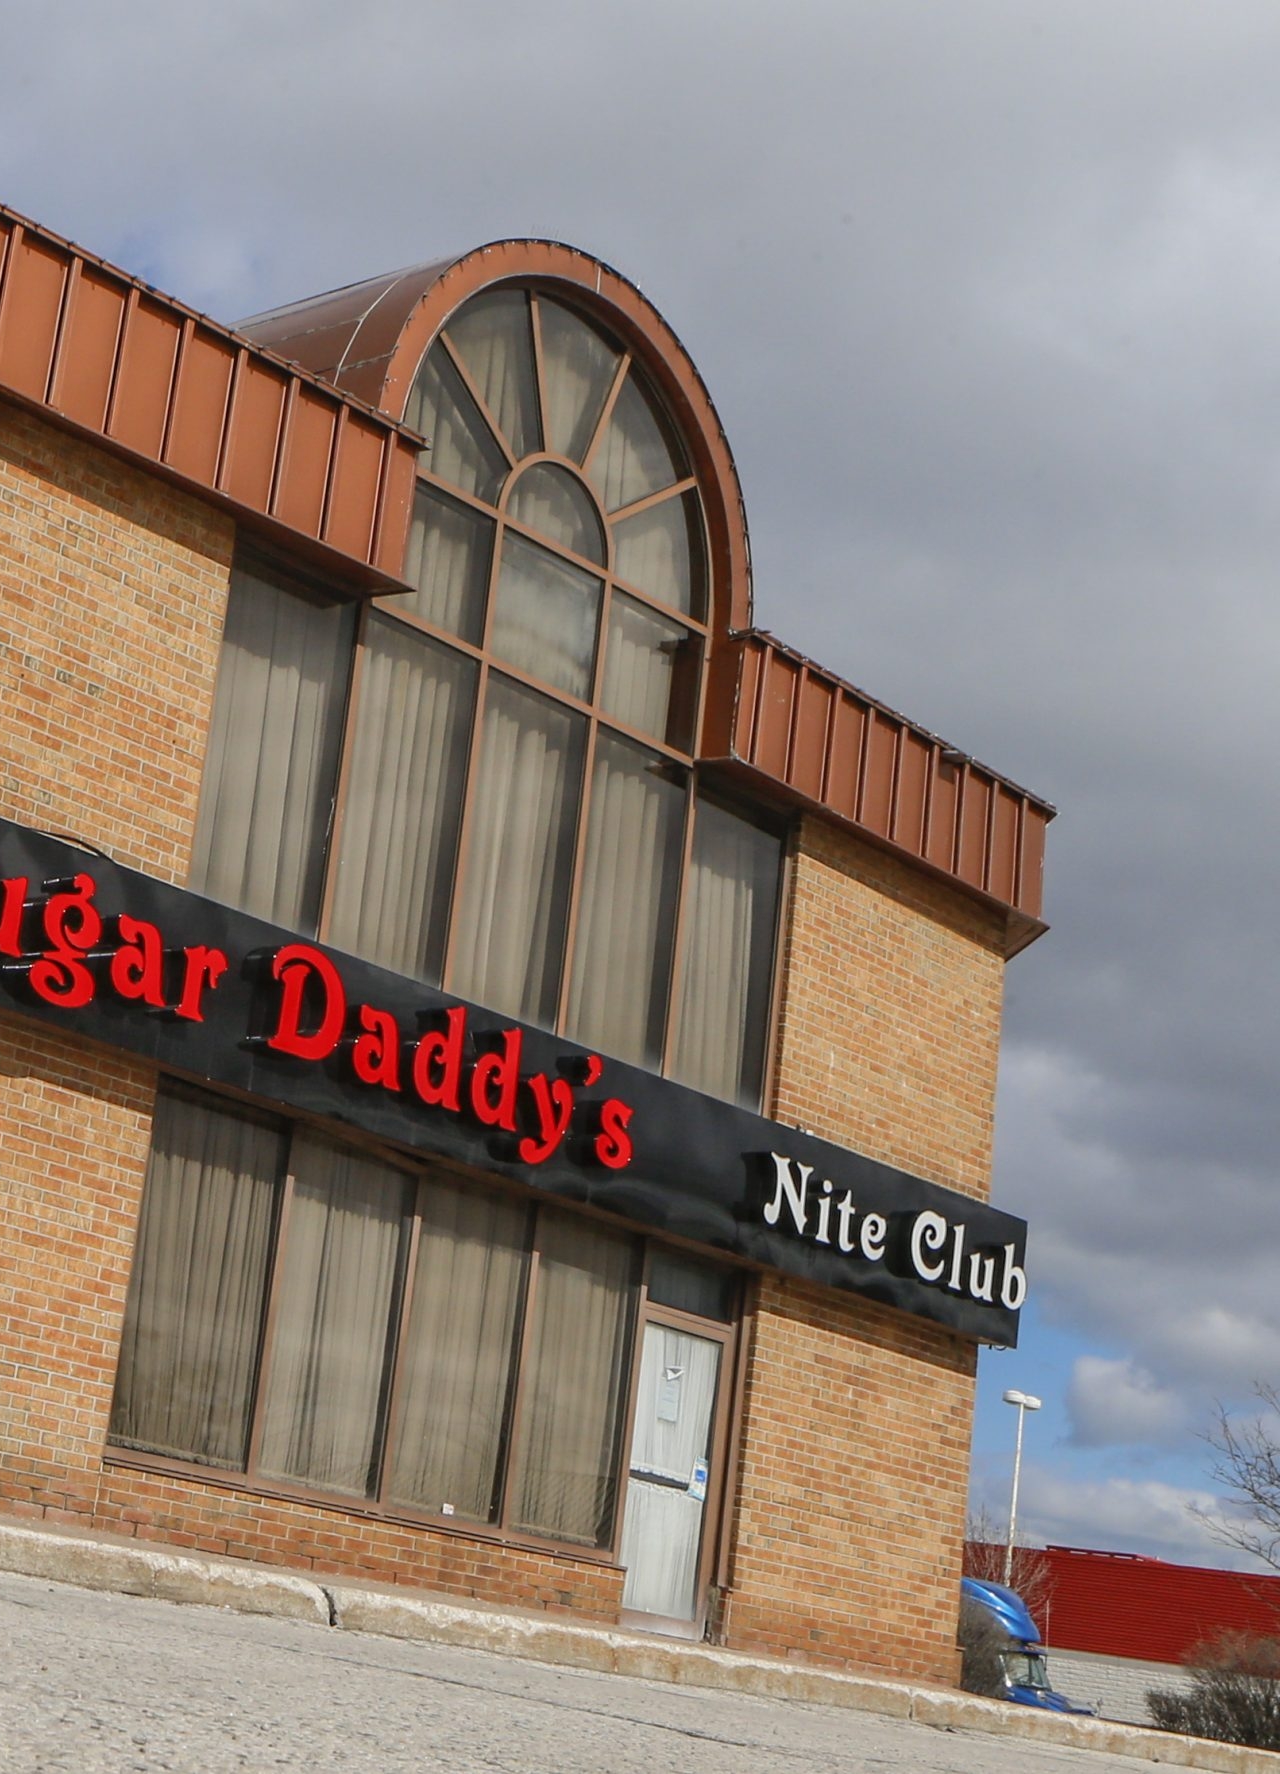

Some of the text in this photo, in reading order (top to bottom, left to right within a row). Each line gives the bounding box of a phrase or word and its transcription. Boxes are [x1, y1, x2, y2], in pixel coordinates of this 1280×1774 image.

[267, 943, 634, 1169] Daddy's
[763, 1150, 1027, 1311] Nite Club
